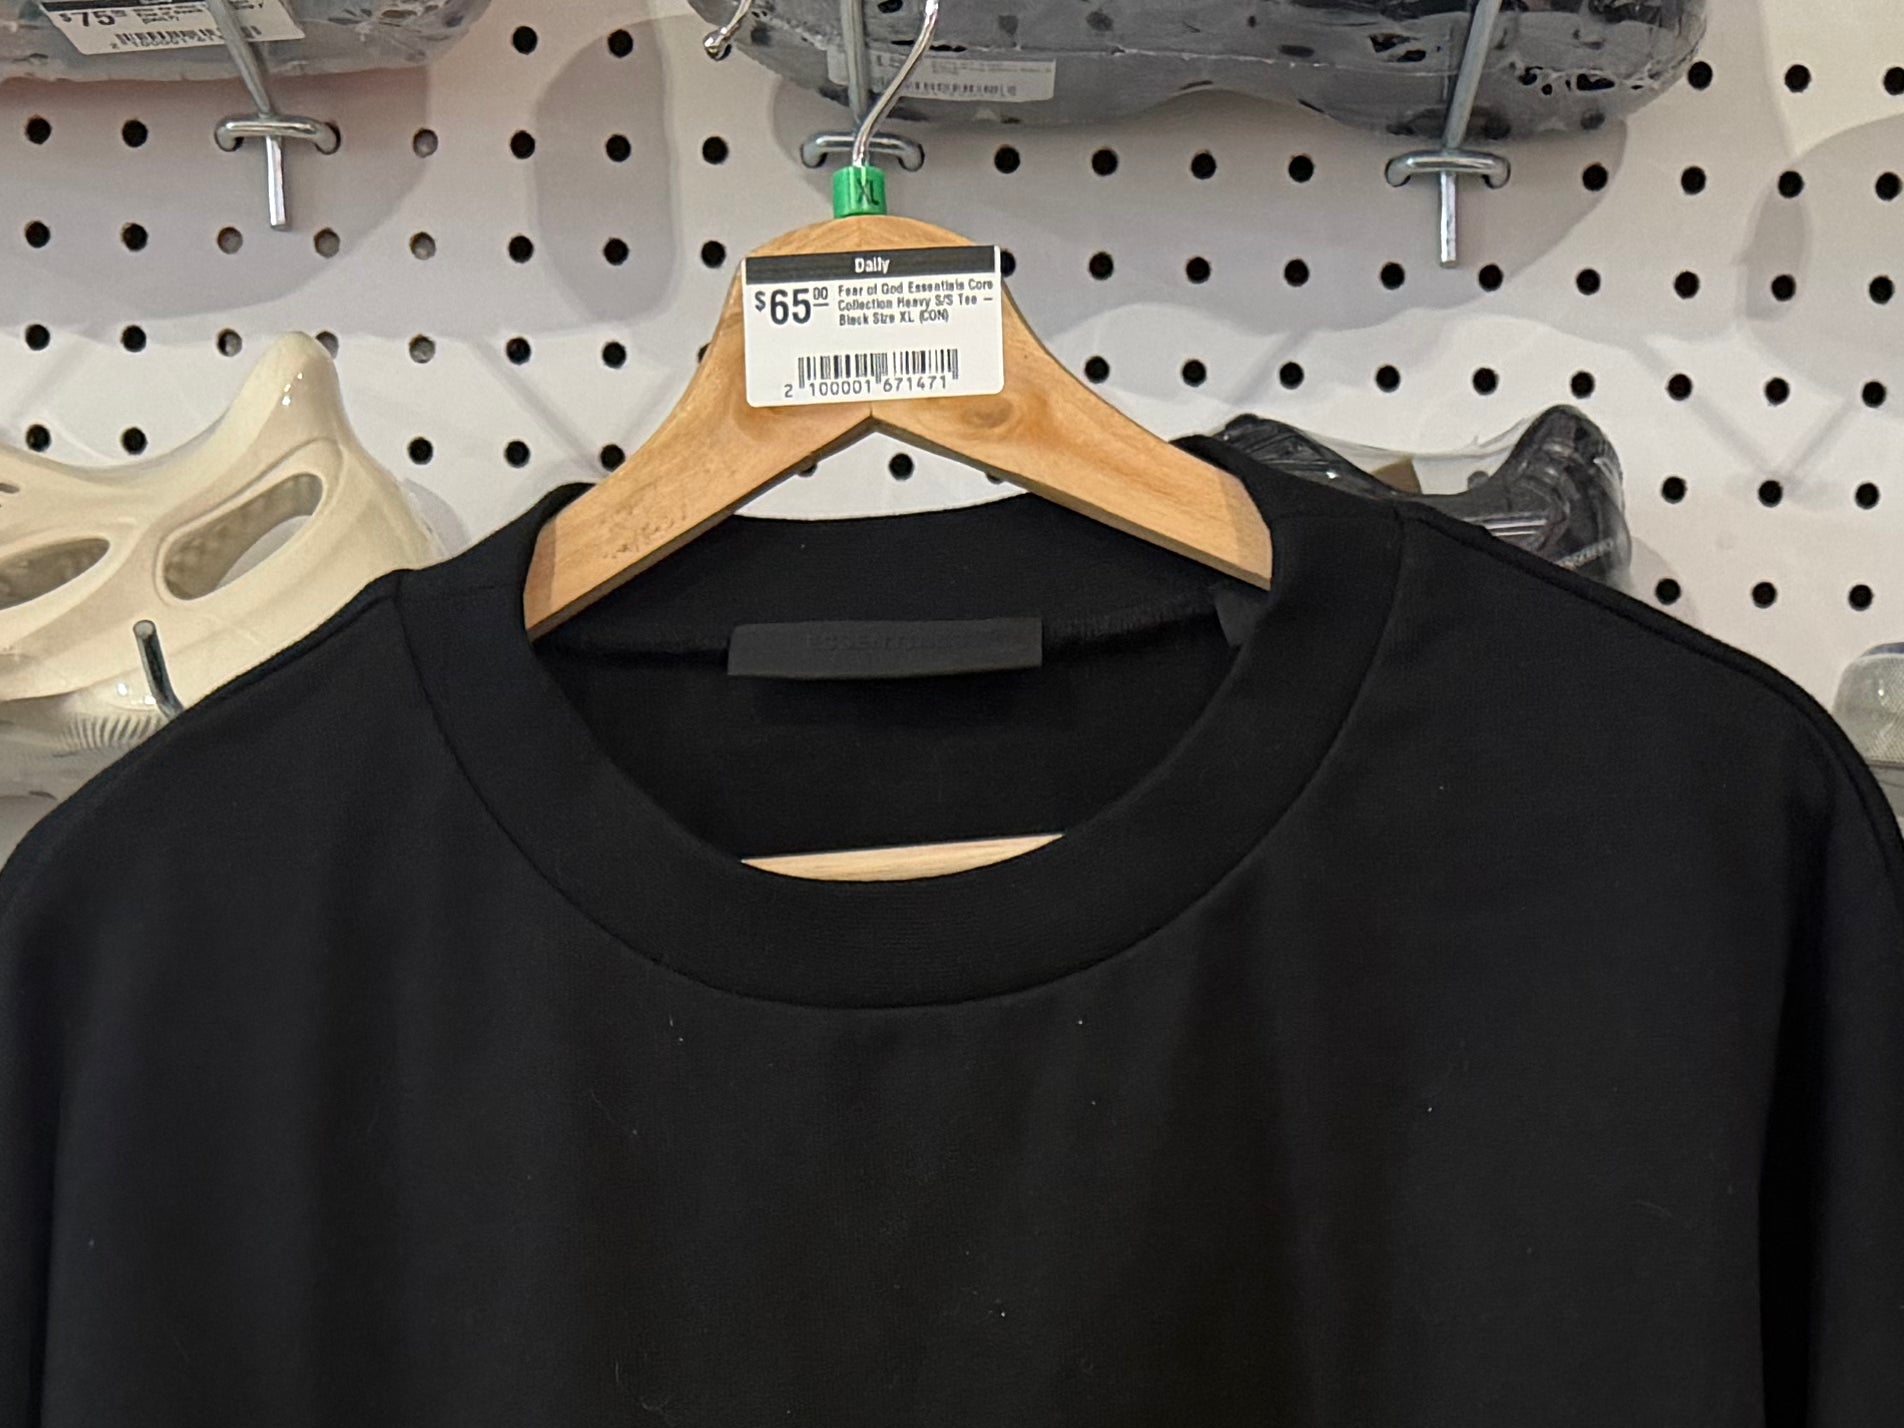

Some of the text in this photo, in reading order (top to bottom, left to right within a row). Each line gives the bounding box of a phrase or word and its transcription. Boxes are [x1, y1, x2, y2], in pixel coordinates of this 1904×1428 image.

[856, 178, 880, 206] XL
[854, 257, 891, 274] Daily
[838, 278, 994, 297] Fear of God Essentials Core
[838, 297, 893, 312] Collection
[897, 295, 932, 311] Heavy
[934, 293, 954, 307] S/S
[958, 292, 978, 306] Tee
[839, 312, 870, 326] Black
[872, 311, 896, 325] Size
[899, 310, 915, 323] XL
[784, 375, 947, 398] 2 100001 671471
